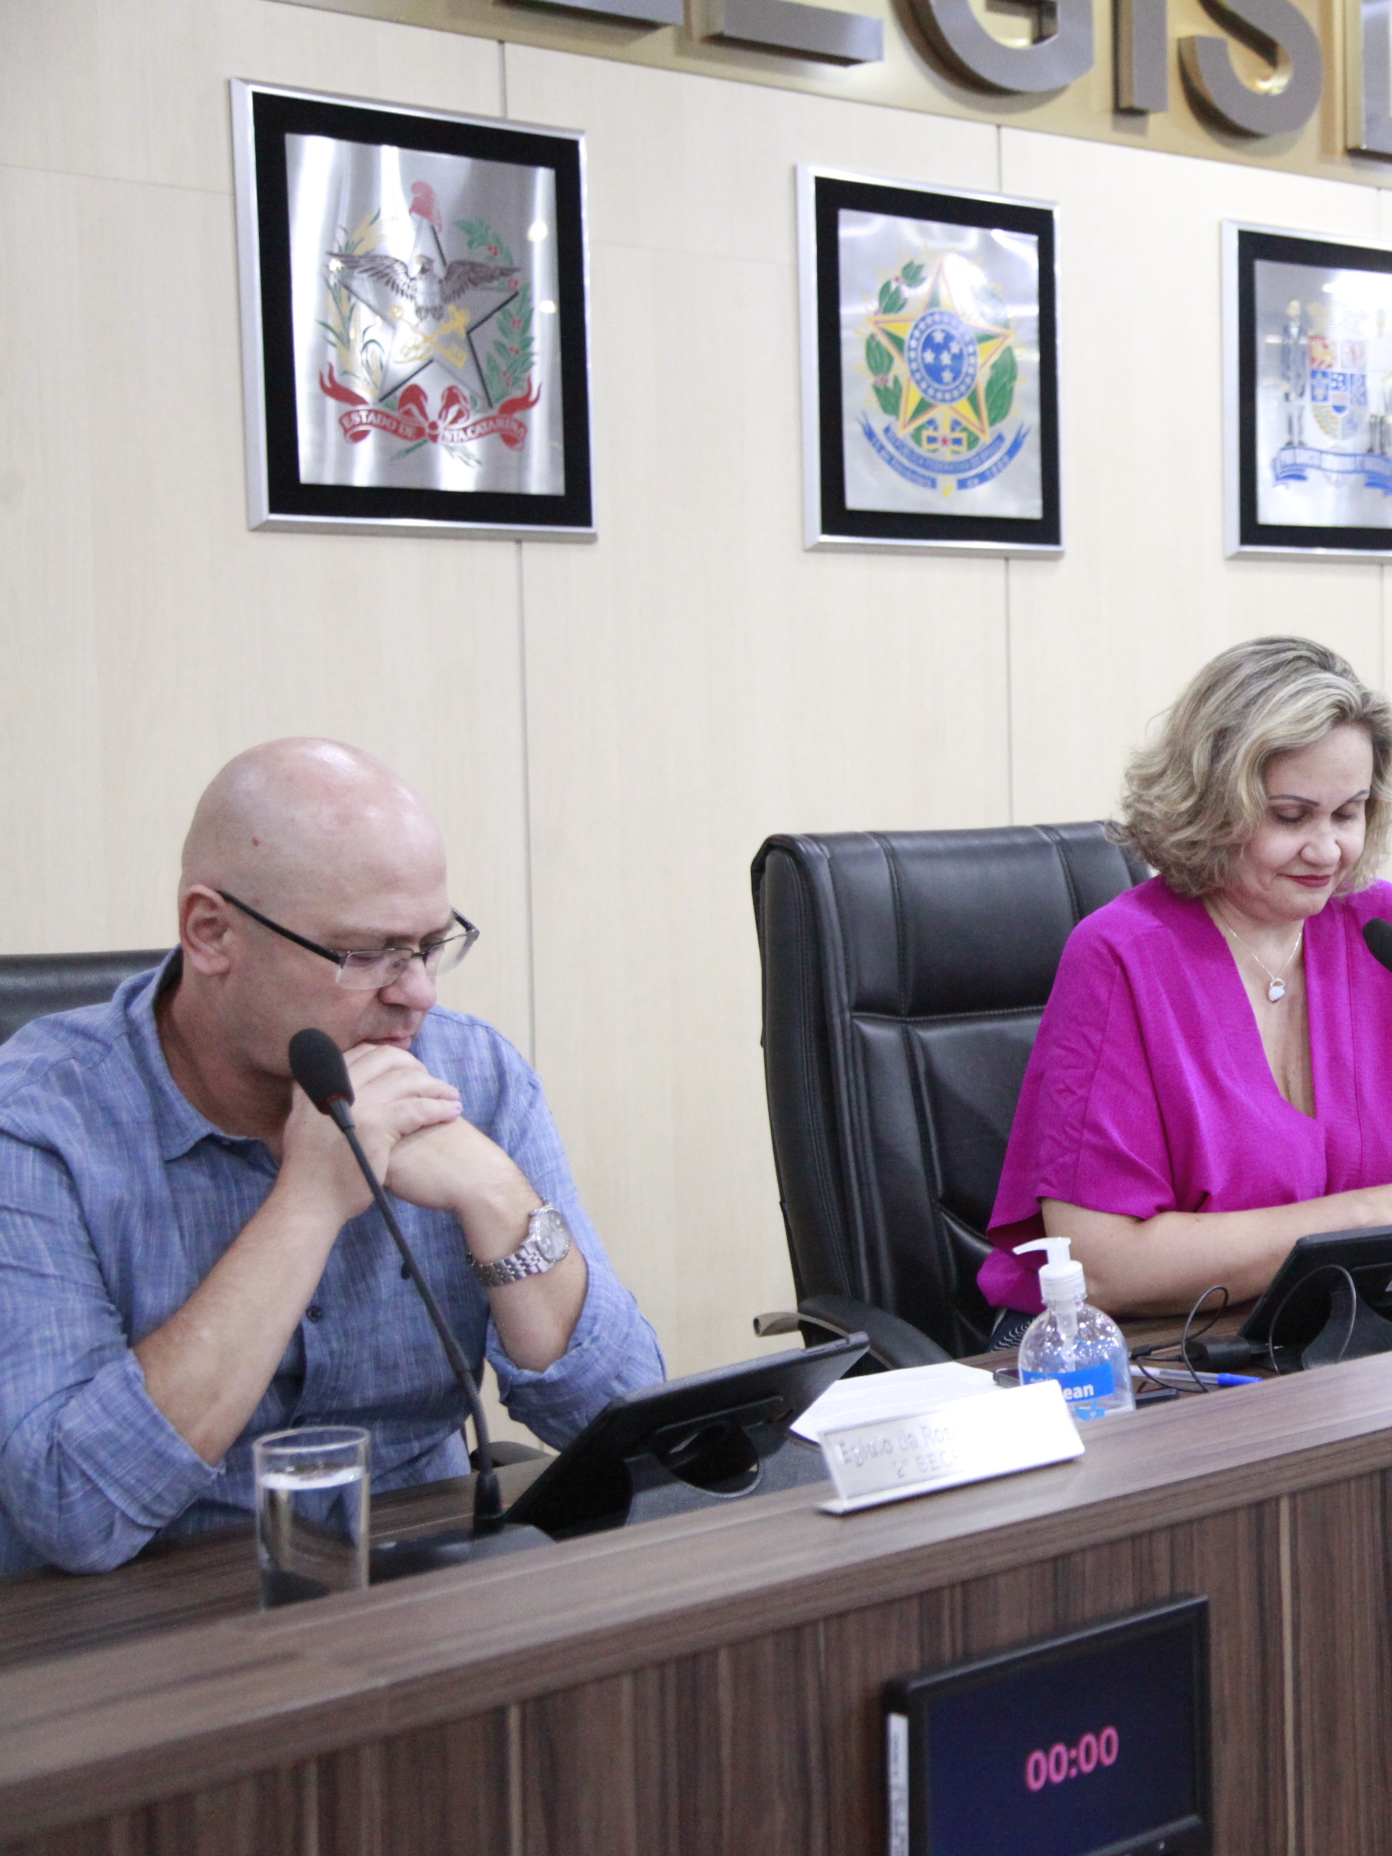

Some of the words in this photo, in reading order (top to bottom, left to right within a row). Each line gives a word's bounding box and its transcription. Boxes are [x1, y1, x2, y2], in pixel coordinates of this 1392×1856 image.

[340, 410, 398, 430] ESTADO
[920, 1424, 960, 1447] Ros
[1025, 1726, 1120, 1792] 00:00
